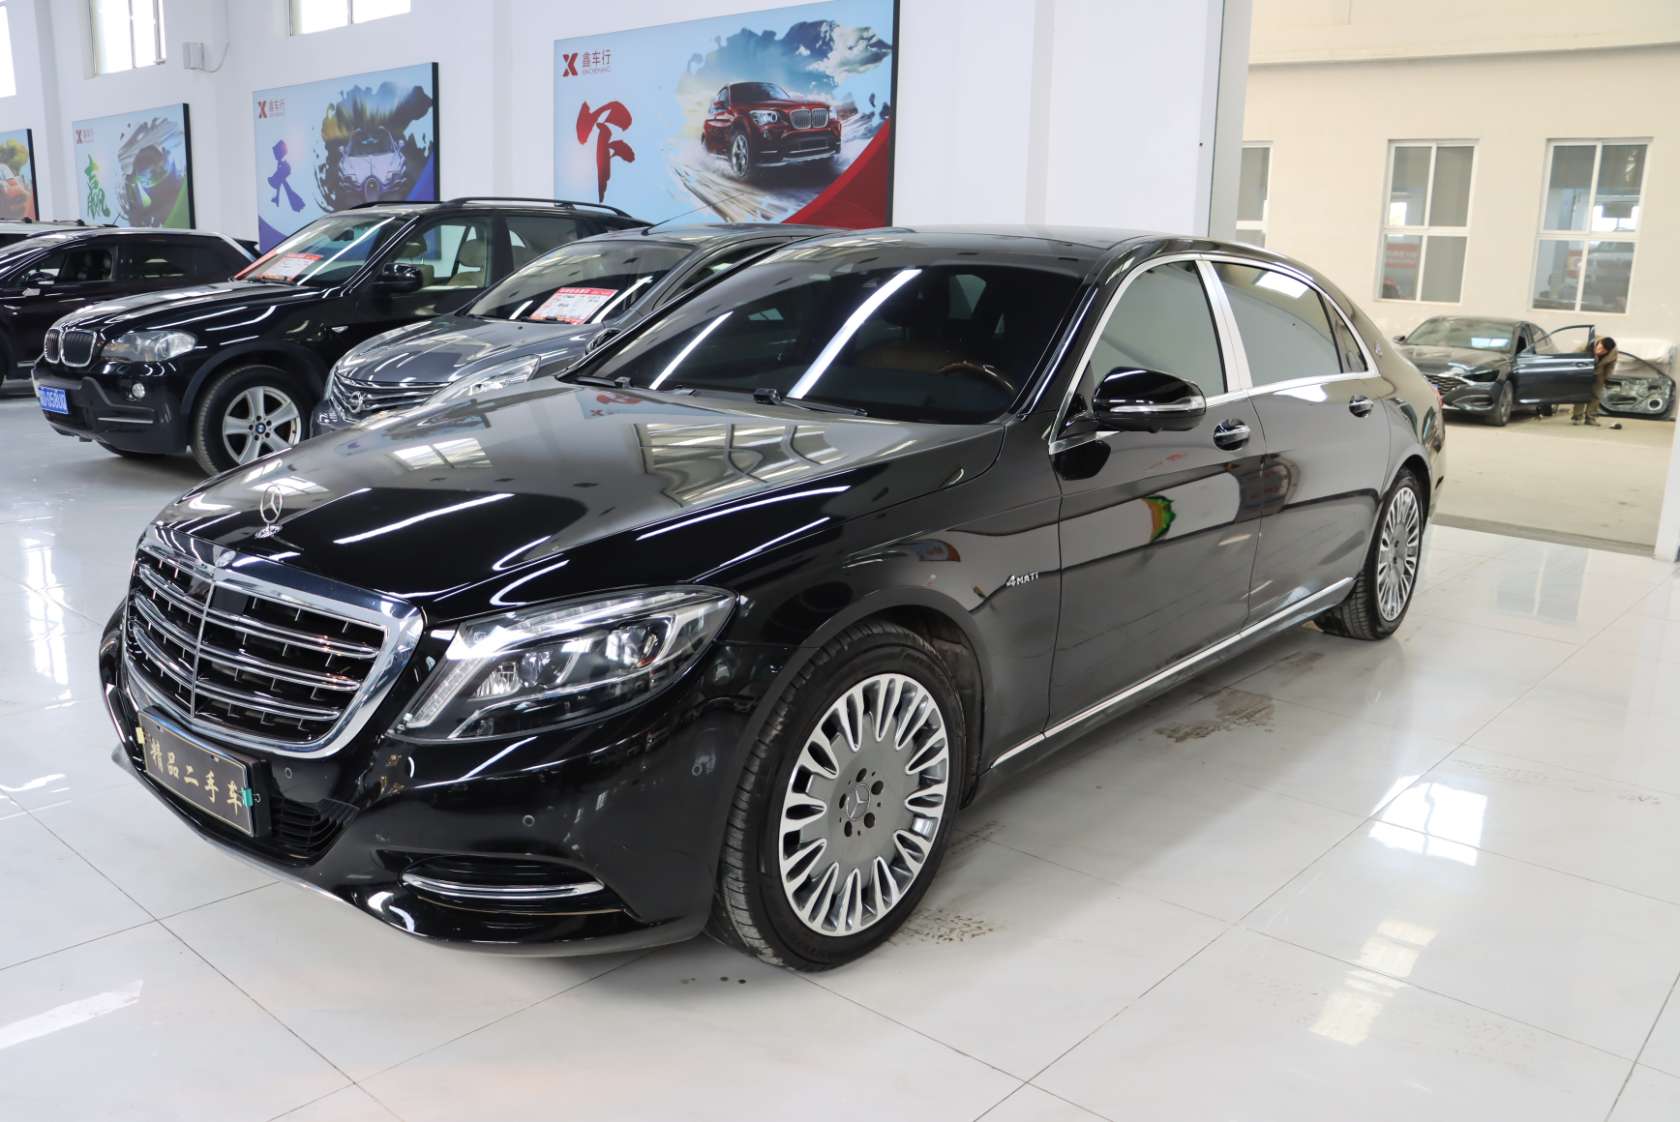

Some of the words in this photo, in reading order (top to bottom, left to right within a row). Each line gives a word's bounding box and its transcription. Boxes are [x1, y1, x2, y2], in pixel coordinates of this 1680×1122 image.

[150, 738, 243, 817] 精品二手车
